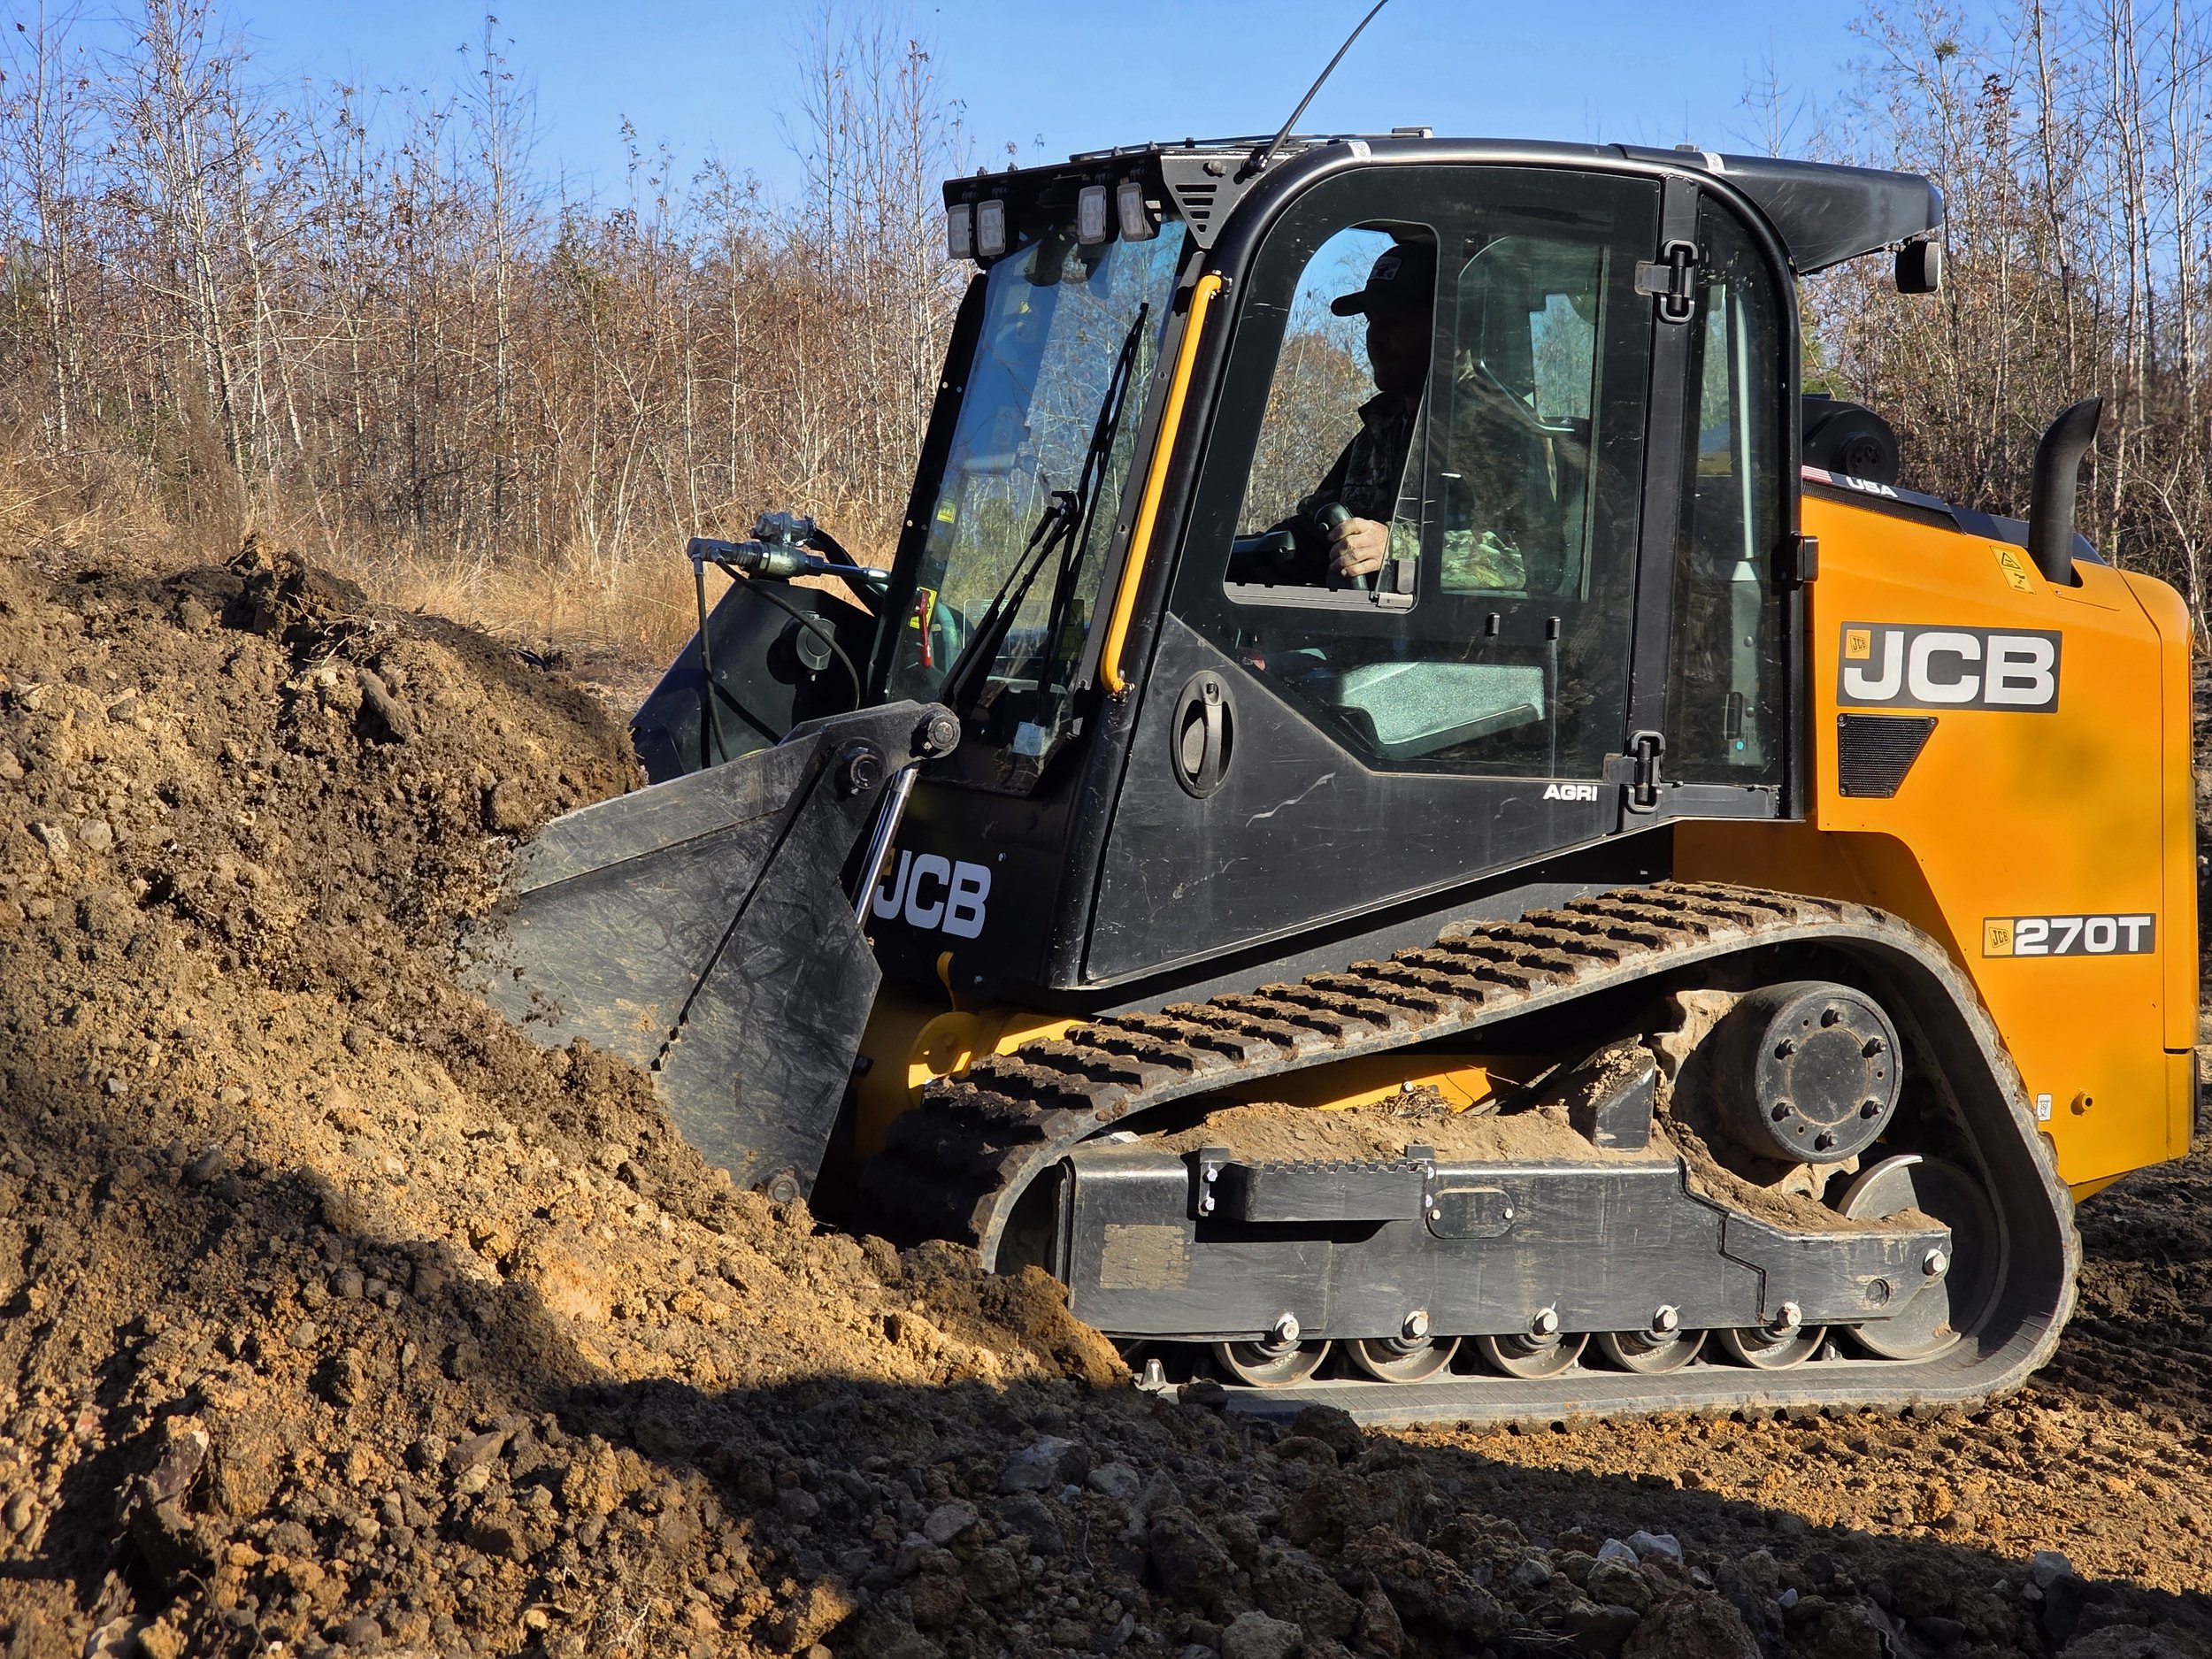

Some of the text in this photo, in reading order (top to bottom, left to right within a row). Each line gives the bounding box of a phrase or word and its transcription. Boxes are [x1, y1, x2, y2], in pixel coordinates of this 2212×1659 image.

[1846, 476, 1899, 498] USA
[1853, 637, 1866, 650] JCB
[1844, 631, 2055, 705] JCB
[1542, 784, 1598, 802] AGRI
[873, 849, 992, 939] JCB
[1992, 929, 2008, 945] JCB
[2015, 917, 2150, 955] 270T
